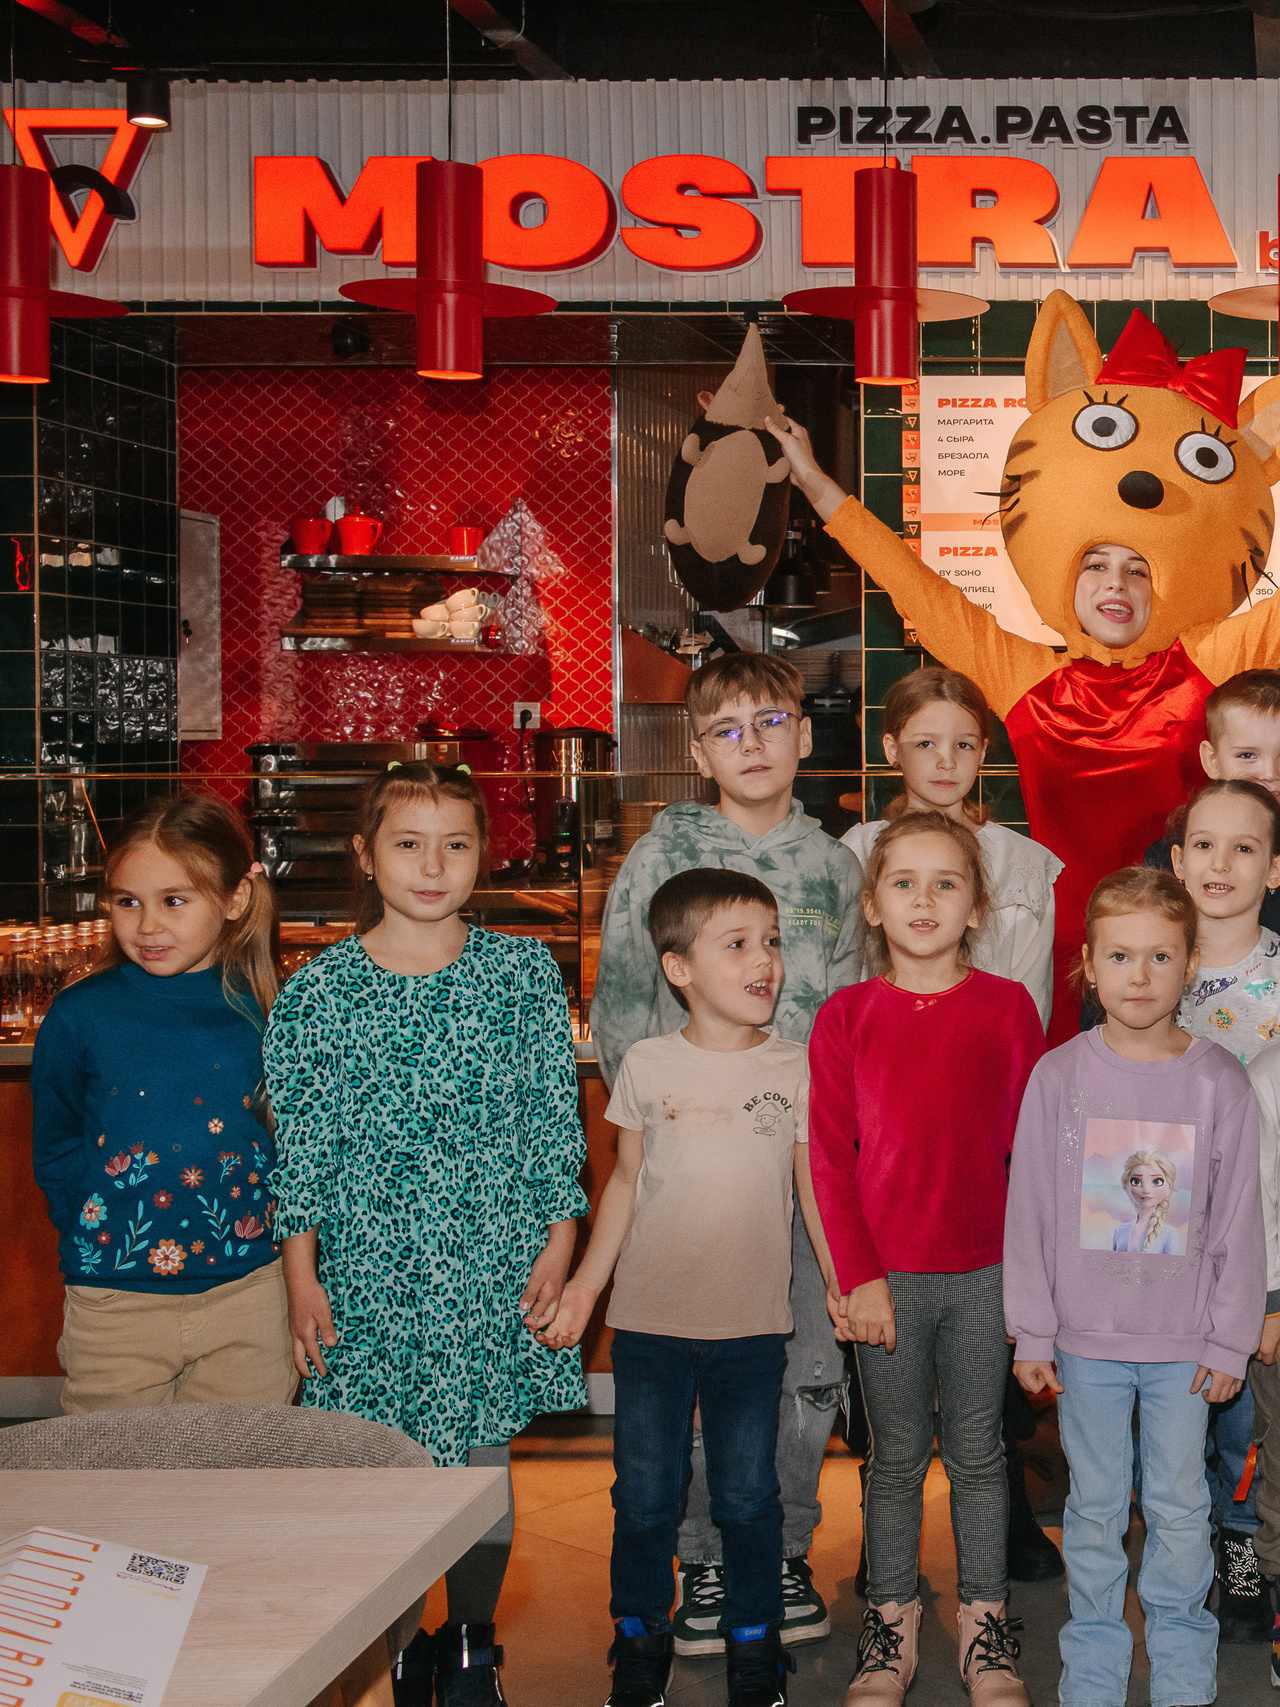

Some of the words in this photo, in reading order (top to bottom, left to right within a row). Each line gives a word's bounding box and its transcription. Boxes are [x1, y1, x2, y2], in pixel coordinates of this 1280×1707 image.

[797, 105, 1189, 145] PIZZA.PASTA
[254, 153, 1238, 268] MOSTRA
[937, 397, 997, 408] PIZZA
[937, 418, 994, 426] МАРГАРИТА
[938, 546, 998, 556] PIZZA
[788, 919, 808, 927] READY
[742, 1095, 762, 1113] BE
[762, 1091, 793, 1114] COOL
